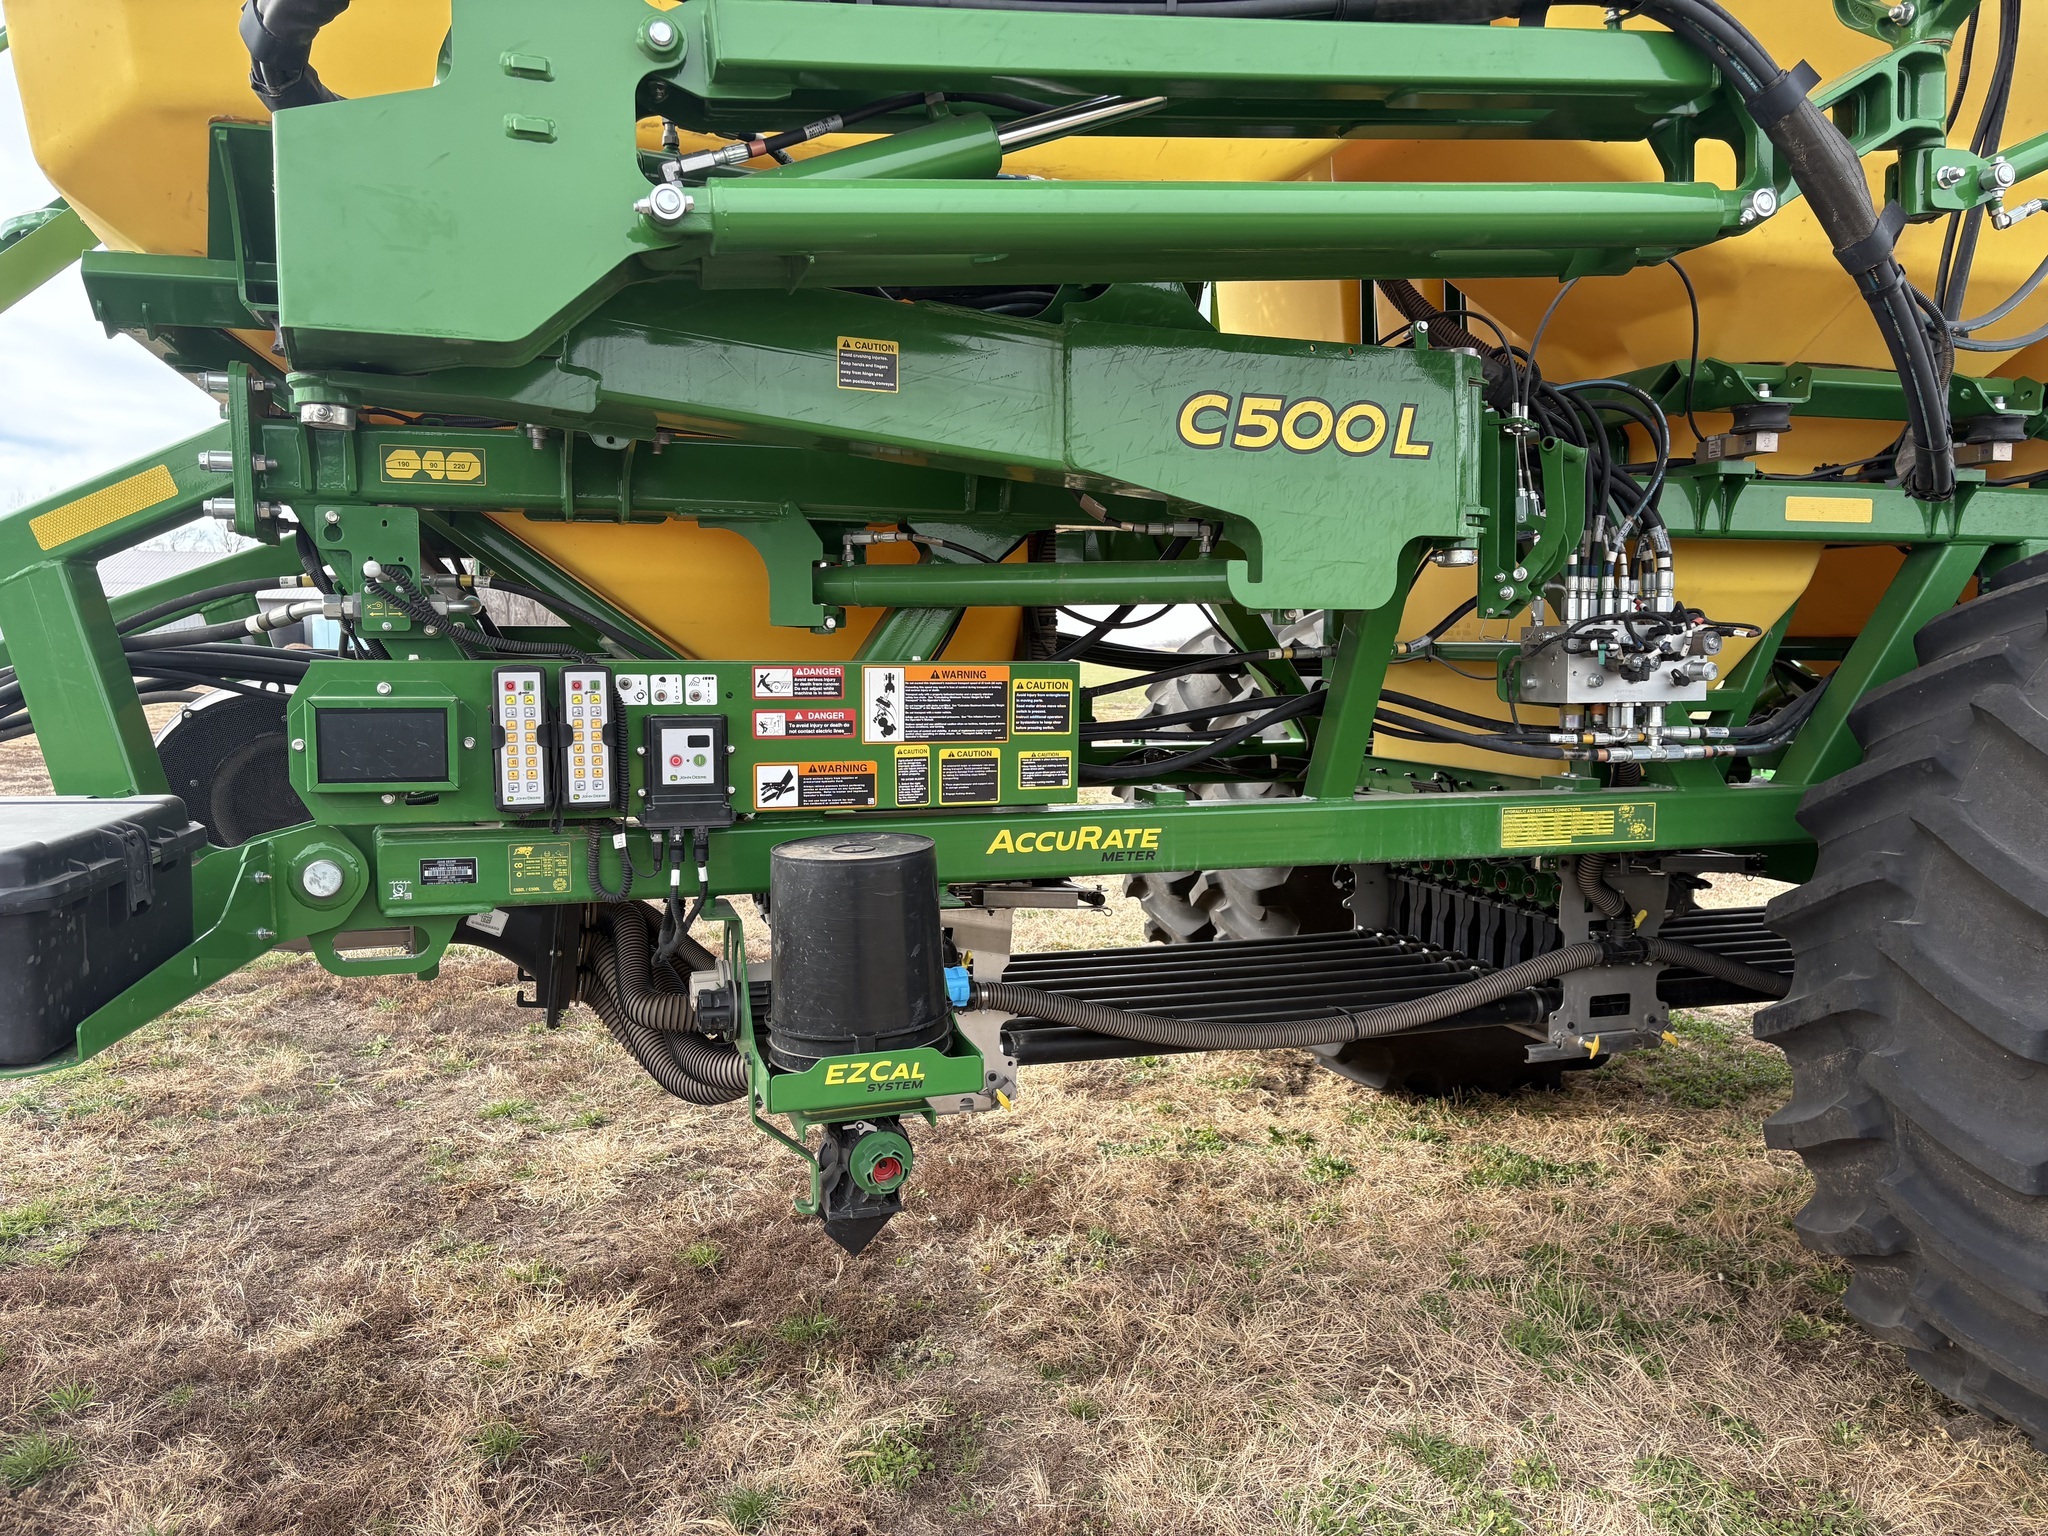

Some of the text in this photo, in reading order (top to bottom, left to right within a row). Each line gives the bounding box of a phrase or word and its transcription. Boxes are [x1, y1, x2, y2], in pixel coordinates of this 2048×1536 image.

[854, 342, 894, 352] CAUTION
[1176, 390, 1434, 460] C500L
[942, 670, 986, 679] WARNING
[818, 764, 867, 773] WARNING
[986, 826, 1162, 854] ACCURATE
[1102, 851, 1156, 862] METER
[825, 1060, 925, 1085] EZCAL
[867, 1080, 924, 1092] SYSTEM
